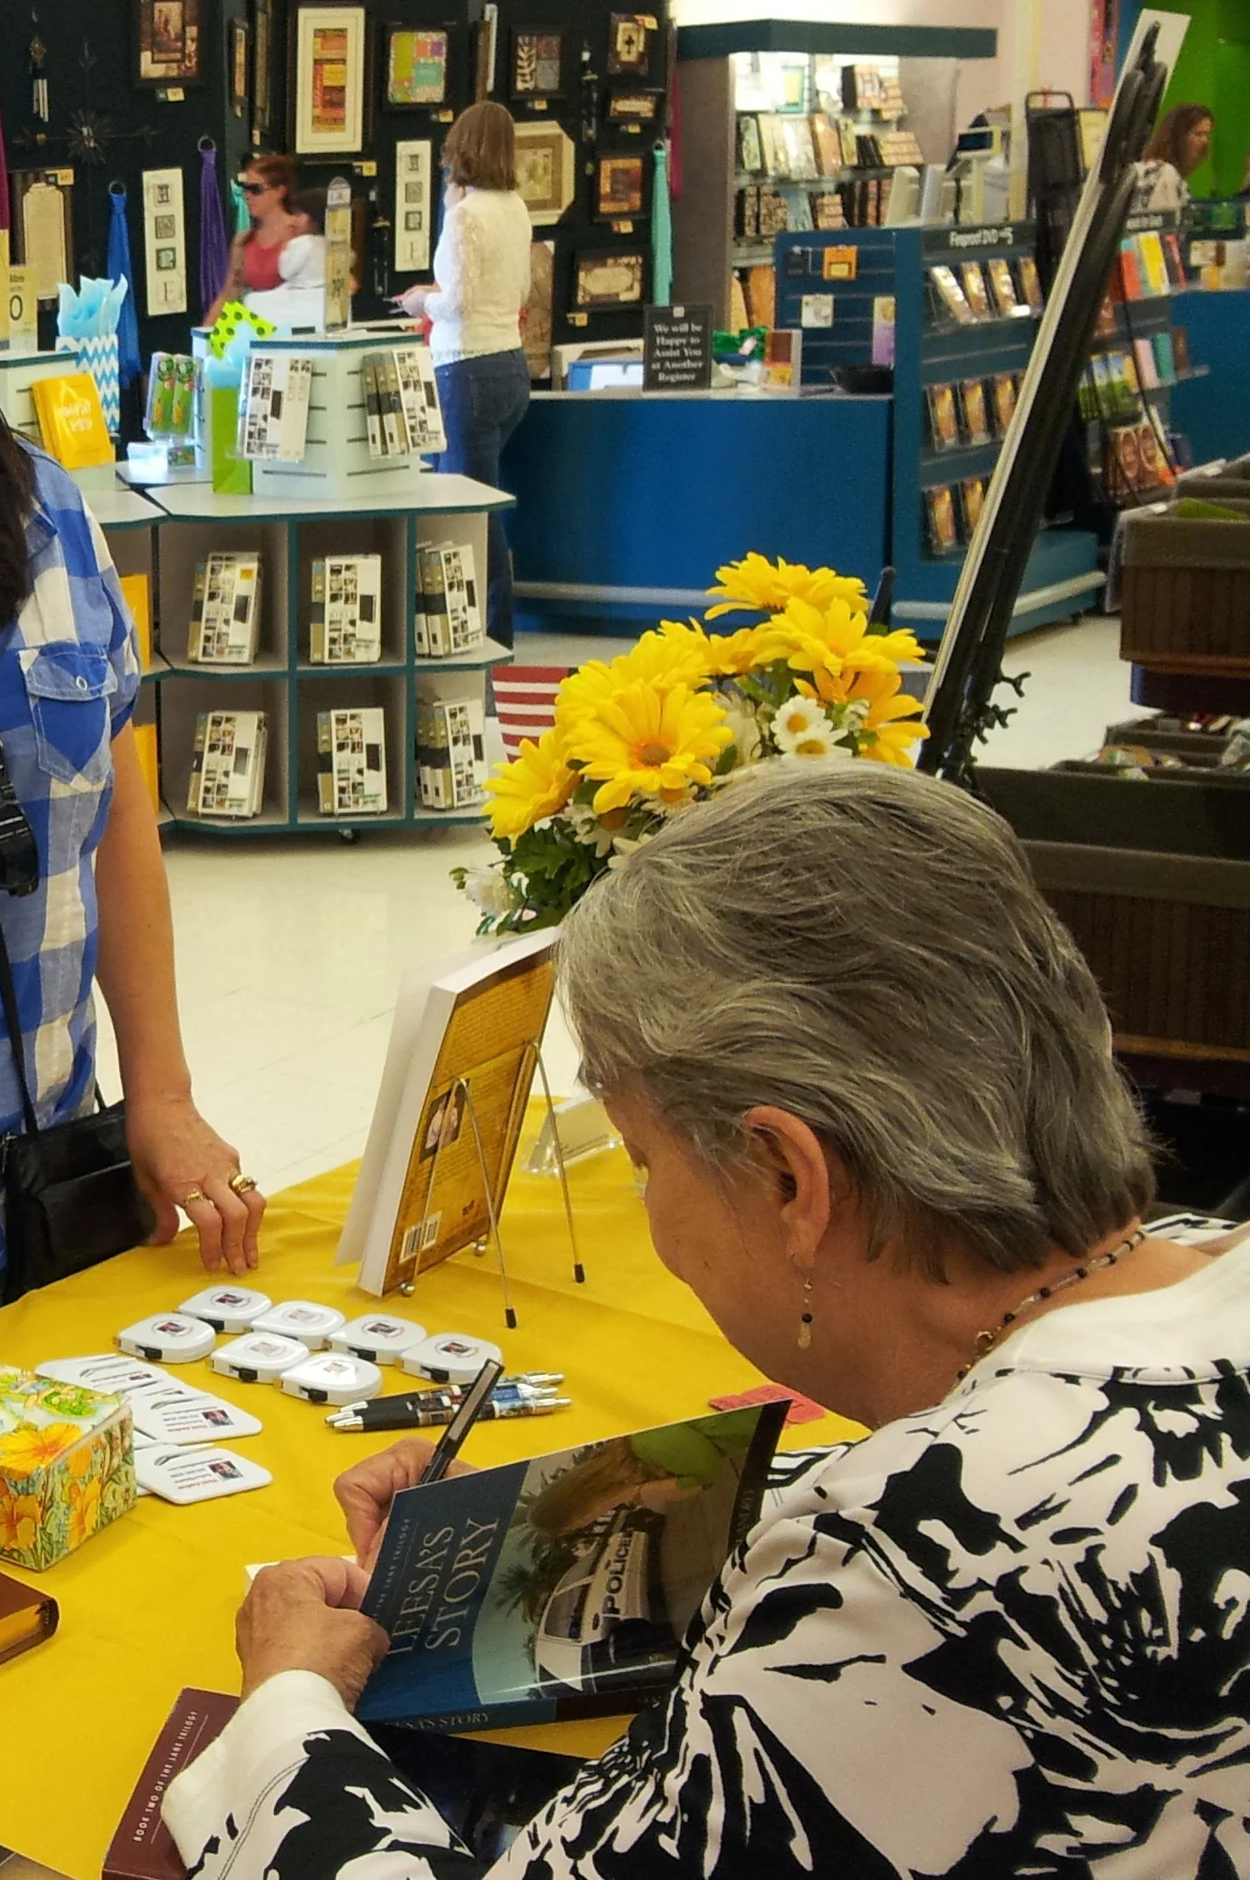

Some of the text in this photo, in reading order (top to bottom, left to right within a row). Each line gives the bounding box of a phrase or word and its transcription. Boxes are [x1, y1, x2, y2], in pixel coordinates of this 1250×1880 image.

[654, 324, 669, 333] We
[671, 323, 689, 332] will
[683, 348, 702, 357] You
[690, 337, 700, 345] to
[386, 1526, 455, 1656] LEESA'S
[424, 1517, 500, 1650] STORY
[602, 1528, 634, 1616] POLICE
[133, 1710, 198, 1842] BOOK TWO OF THE LANE TRILOGY
